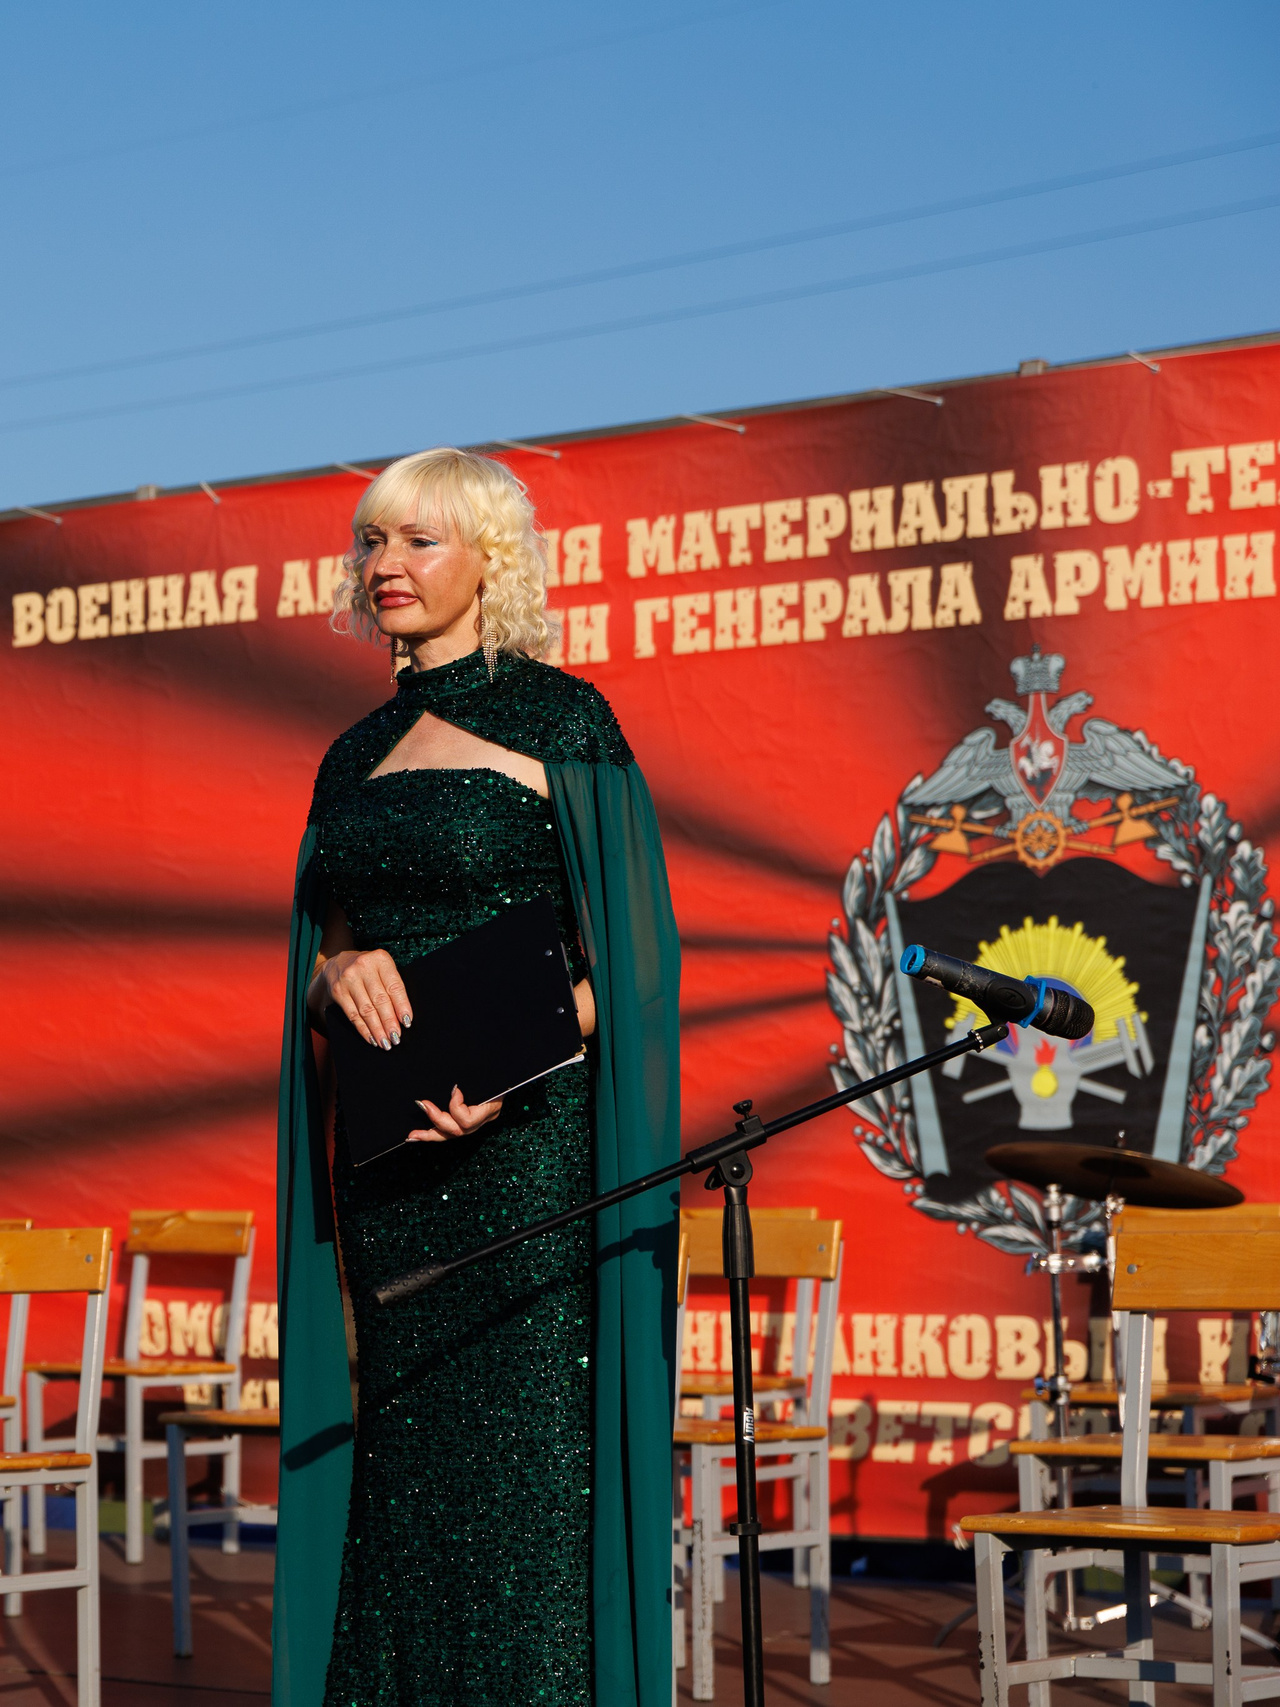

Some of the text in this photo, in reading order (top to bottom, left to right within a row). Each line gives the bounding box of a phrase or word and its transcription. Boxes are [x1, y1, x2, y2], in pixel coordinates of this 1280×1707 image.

[11, 564, 259, 648] ВОЕННАЯ
[625, 438, 1280, 579] МАТЕРИАЛЬНО-ТЕ
[633, 562, 983, 659] ГЕНЕРАЛА
[1003, 530, 1278, 621] АРМИИ
